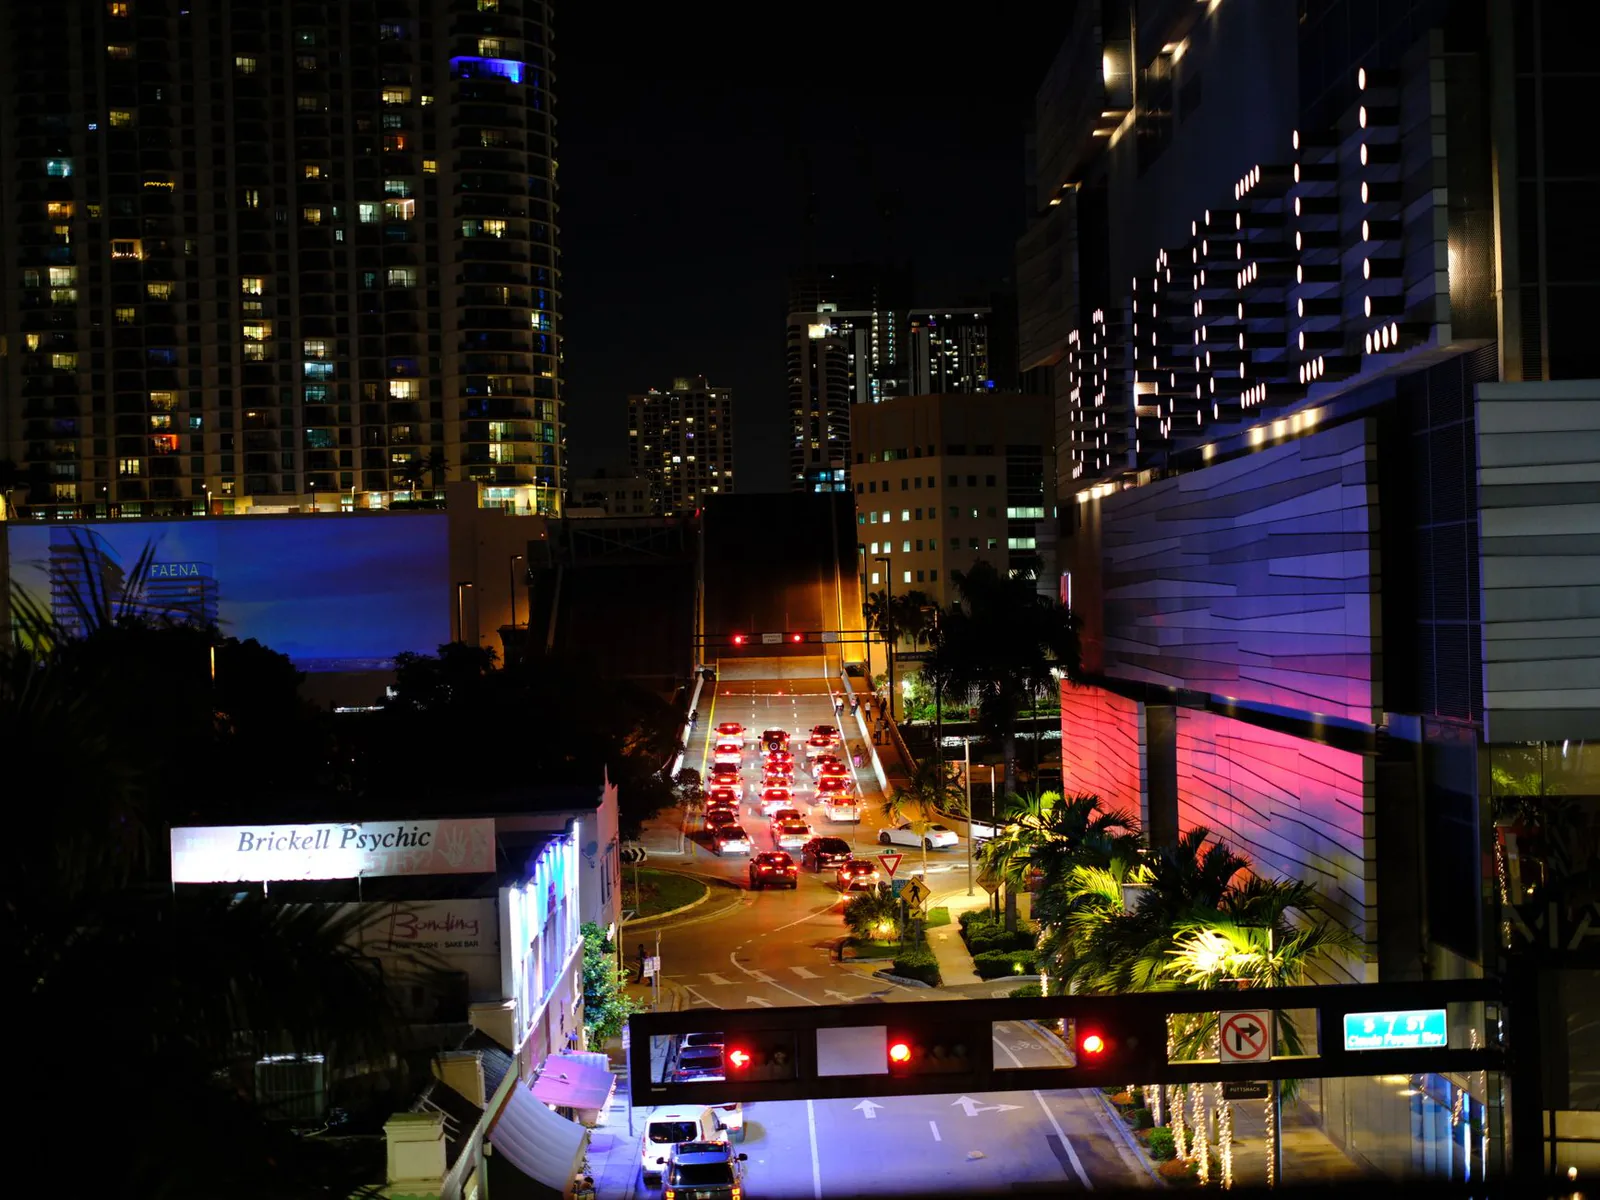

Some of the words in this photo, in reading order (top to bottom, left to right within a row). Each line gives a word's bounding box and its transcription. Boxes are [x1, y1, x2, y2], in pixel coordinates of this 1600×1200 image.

[151, 563, 199, 576] FAENA
[236, 828, 332, 852] Brickell
[339, 825, 432, 852] Psychic
